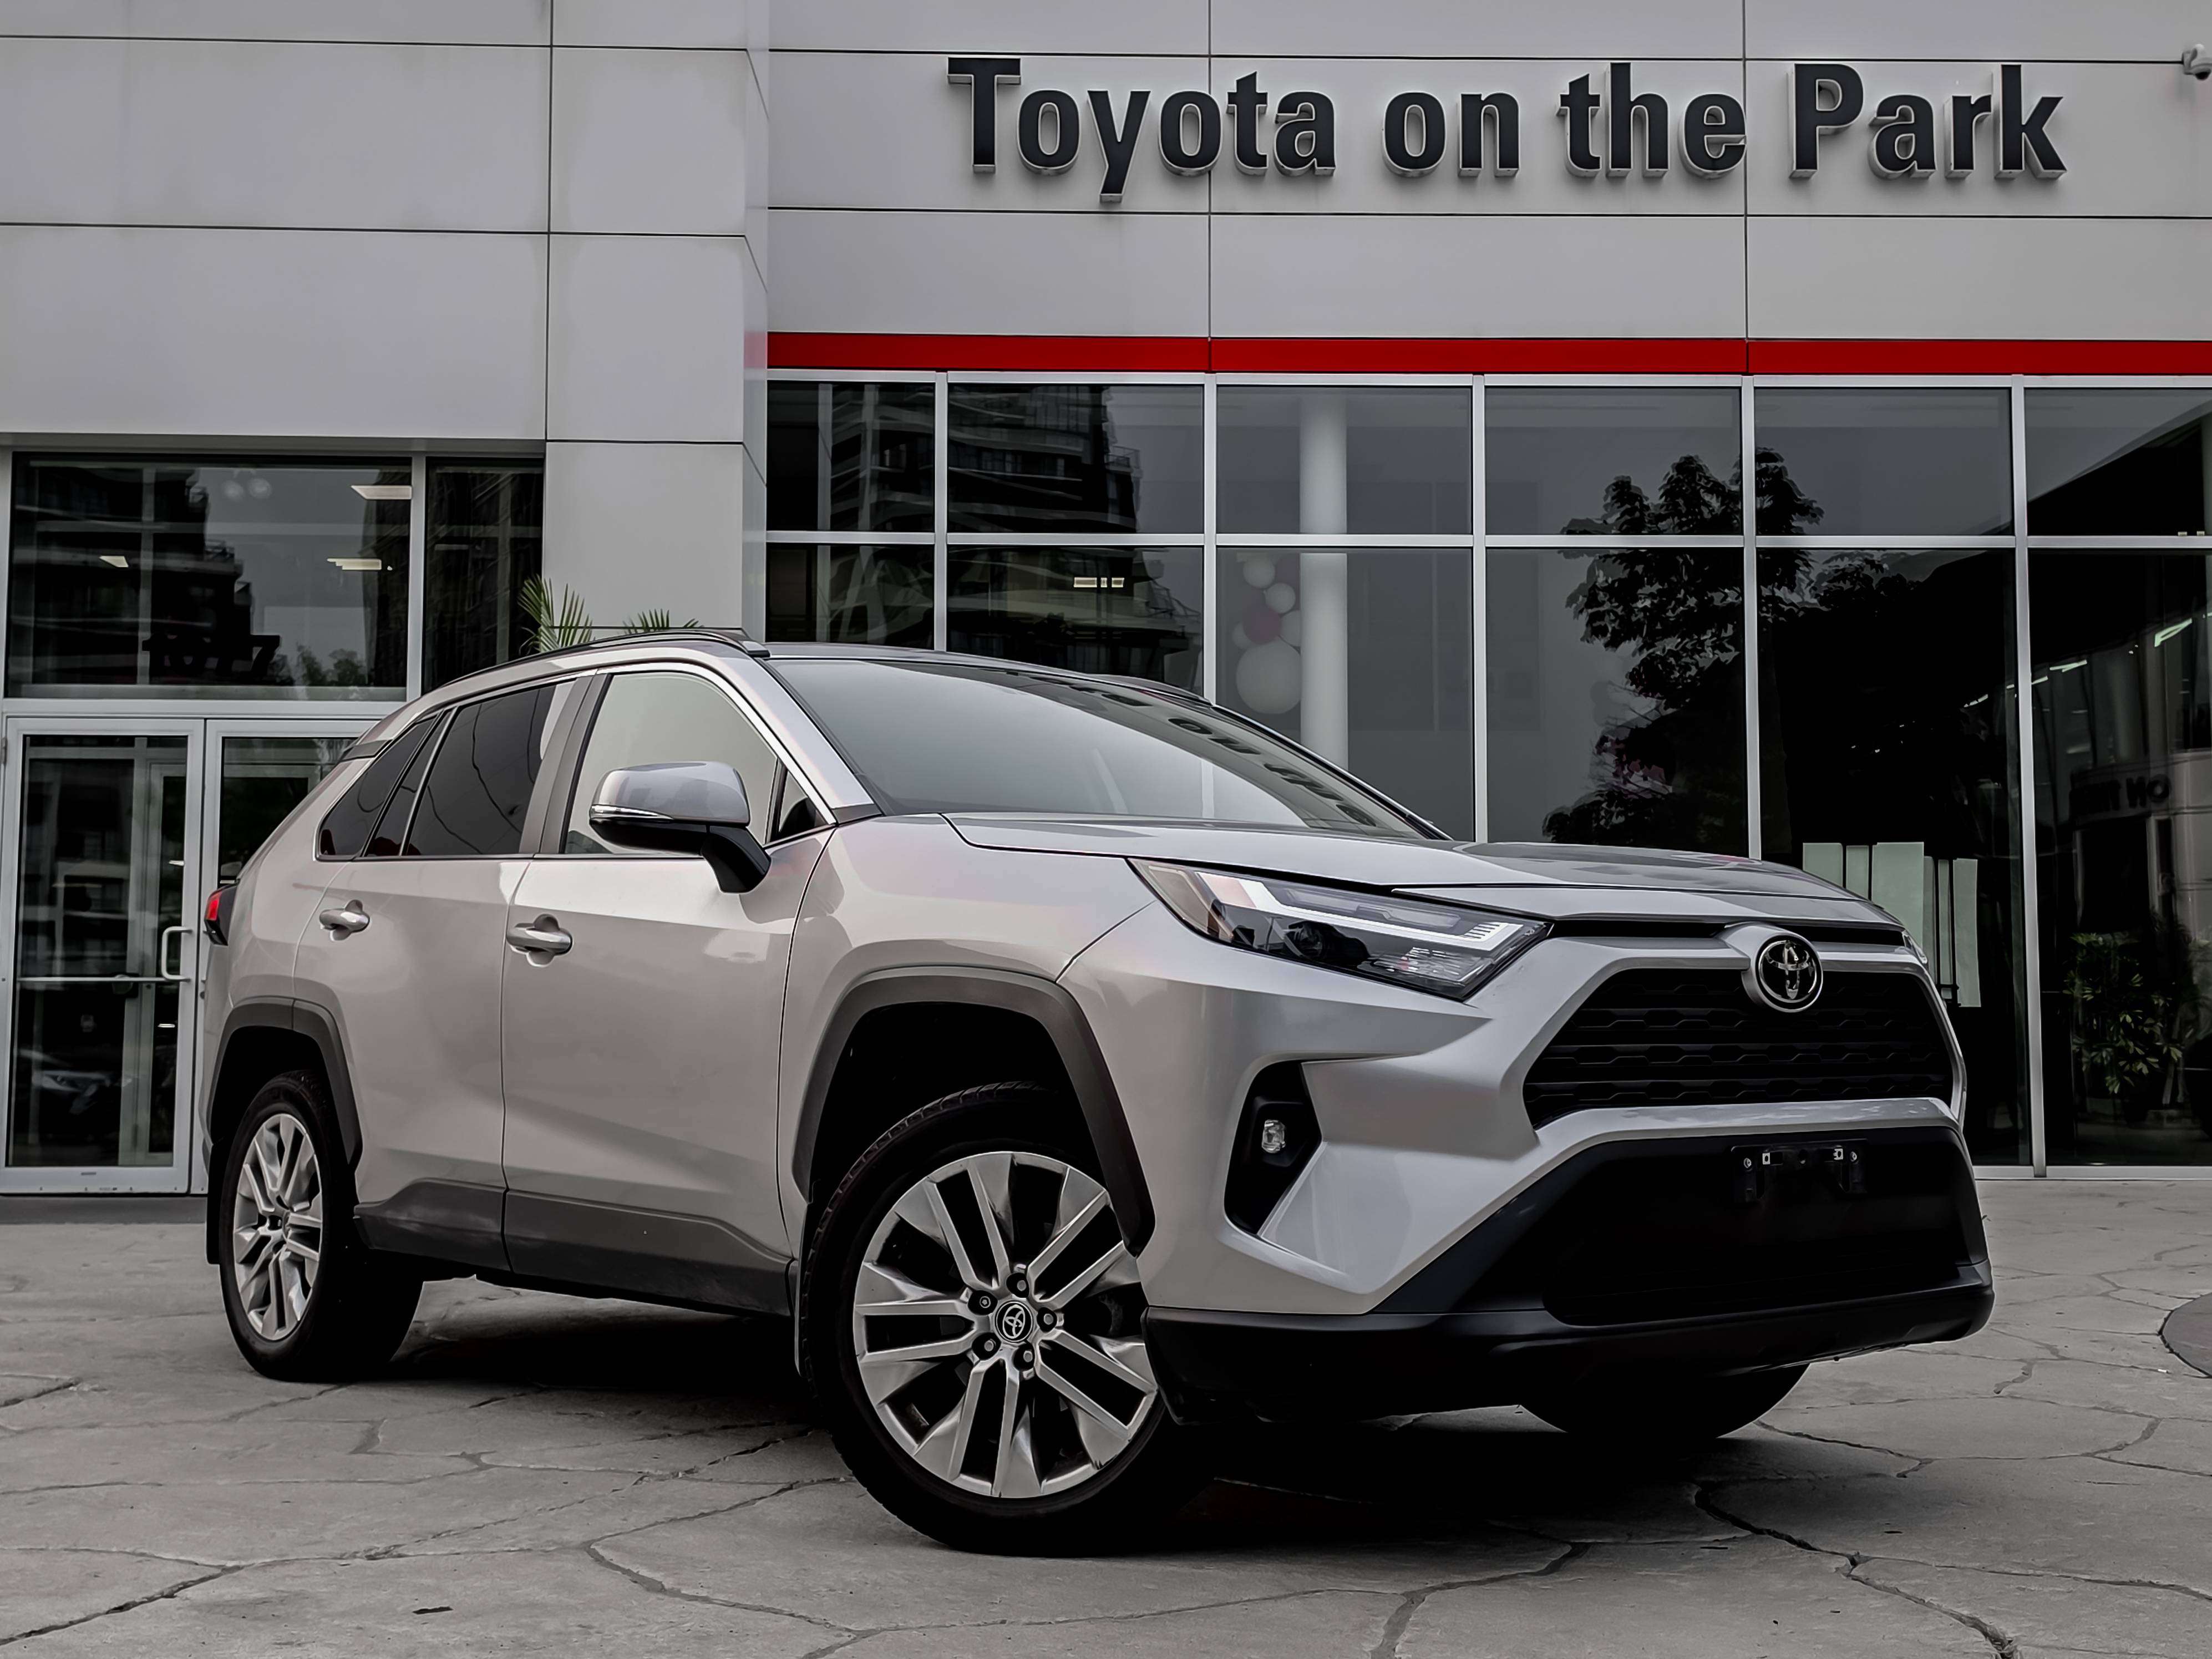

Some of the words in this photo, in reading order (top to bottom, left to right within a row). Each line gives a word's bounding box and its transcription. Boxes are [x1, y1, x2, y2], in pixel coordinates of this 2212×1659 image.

[947, 57, 1336, 202] Toyota
[1383, 92, 1520, 177] on
[1556, 62, 1746, 178] the
[1789, 63, 2067, 179] Park
